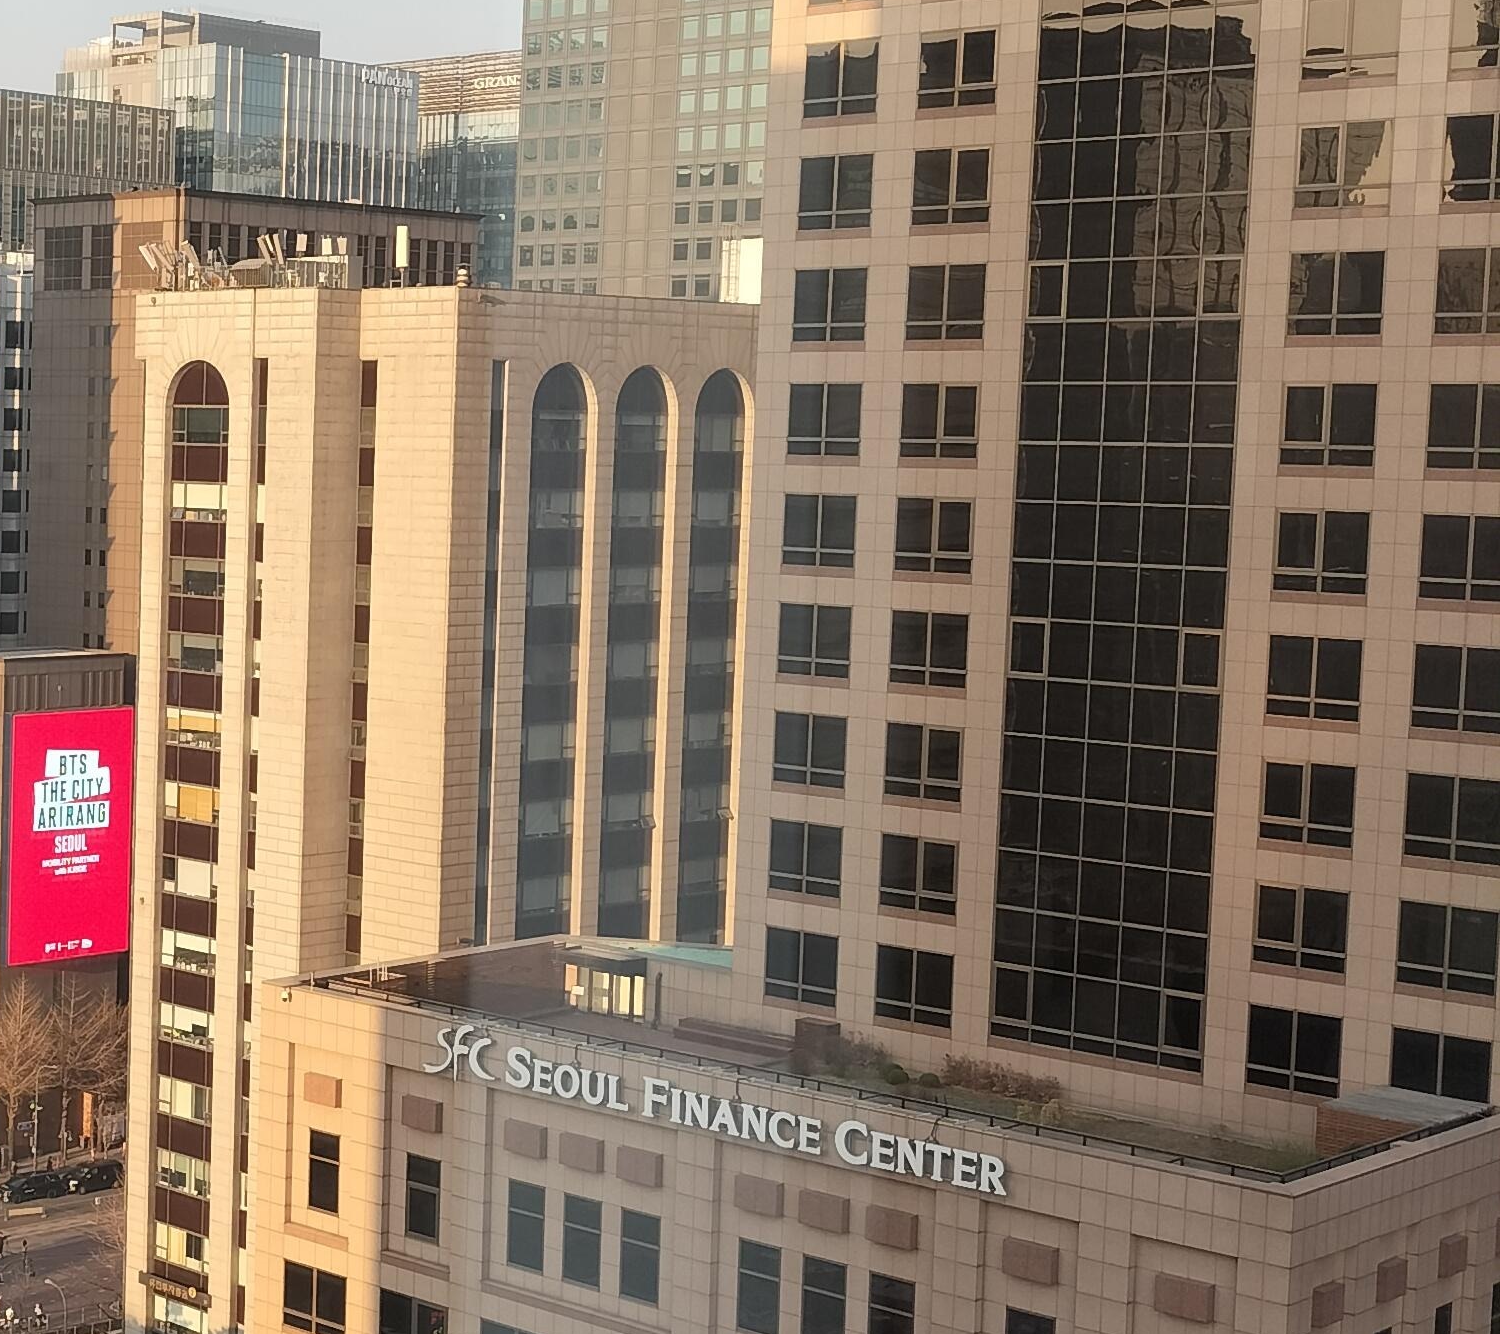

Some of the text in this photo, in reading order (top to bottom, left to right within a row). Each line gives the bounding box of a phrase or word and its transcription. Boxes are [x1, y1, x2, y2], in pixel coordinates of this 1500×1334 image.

[59, 753, 87, 776] BTS
[41, 776, 104, 803] THE CITY
[37, 802, 106, 829] ARIRANG
[54, 833, 88, 854] SEOUL
[505, 1045, 629, 1113] SEOUL
[641, 1076, 822, 1156] FINANCE
[834, 1119, 1007, 1197] CENTER
